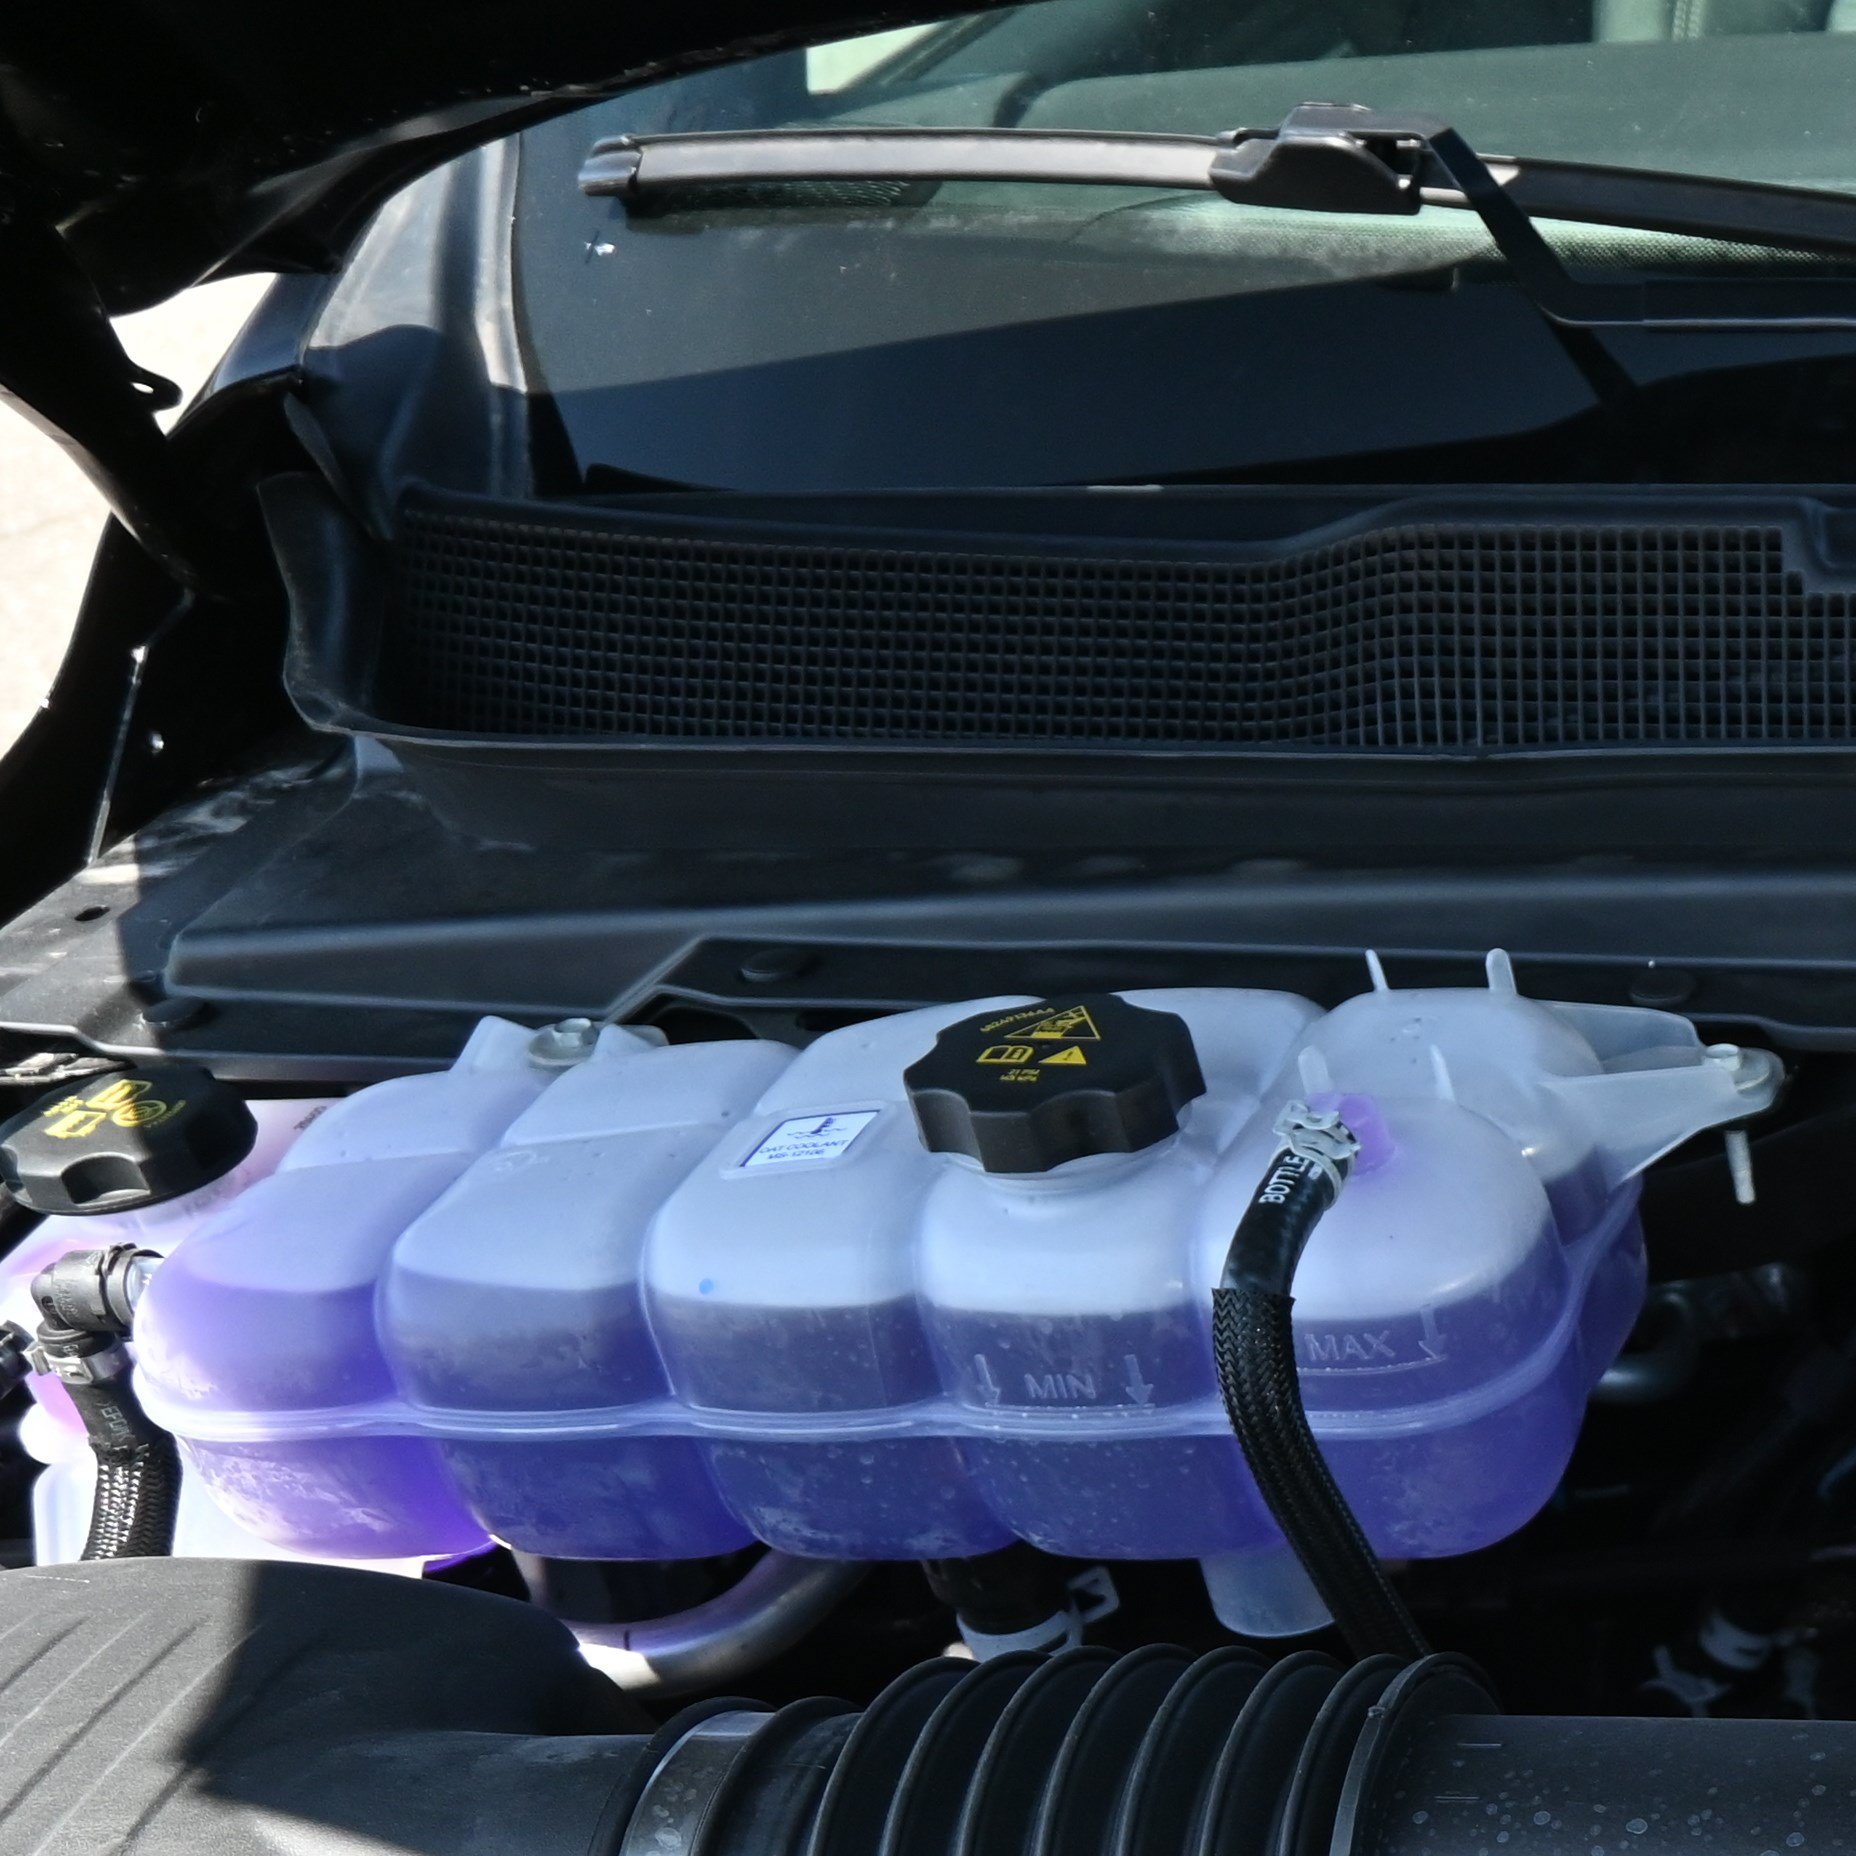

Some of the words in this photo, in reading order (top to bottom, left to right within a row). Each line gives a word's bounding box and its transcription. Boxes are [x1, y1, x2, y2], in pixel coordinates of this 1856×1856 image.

[1259, 1156, 1309, 1204] BOTTLE
[1304, 1330, 1396, 1361] MAX
[1024, 1373, 1096, 1400] MIN
